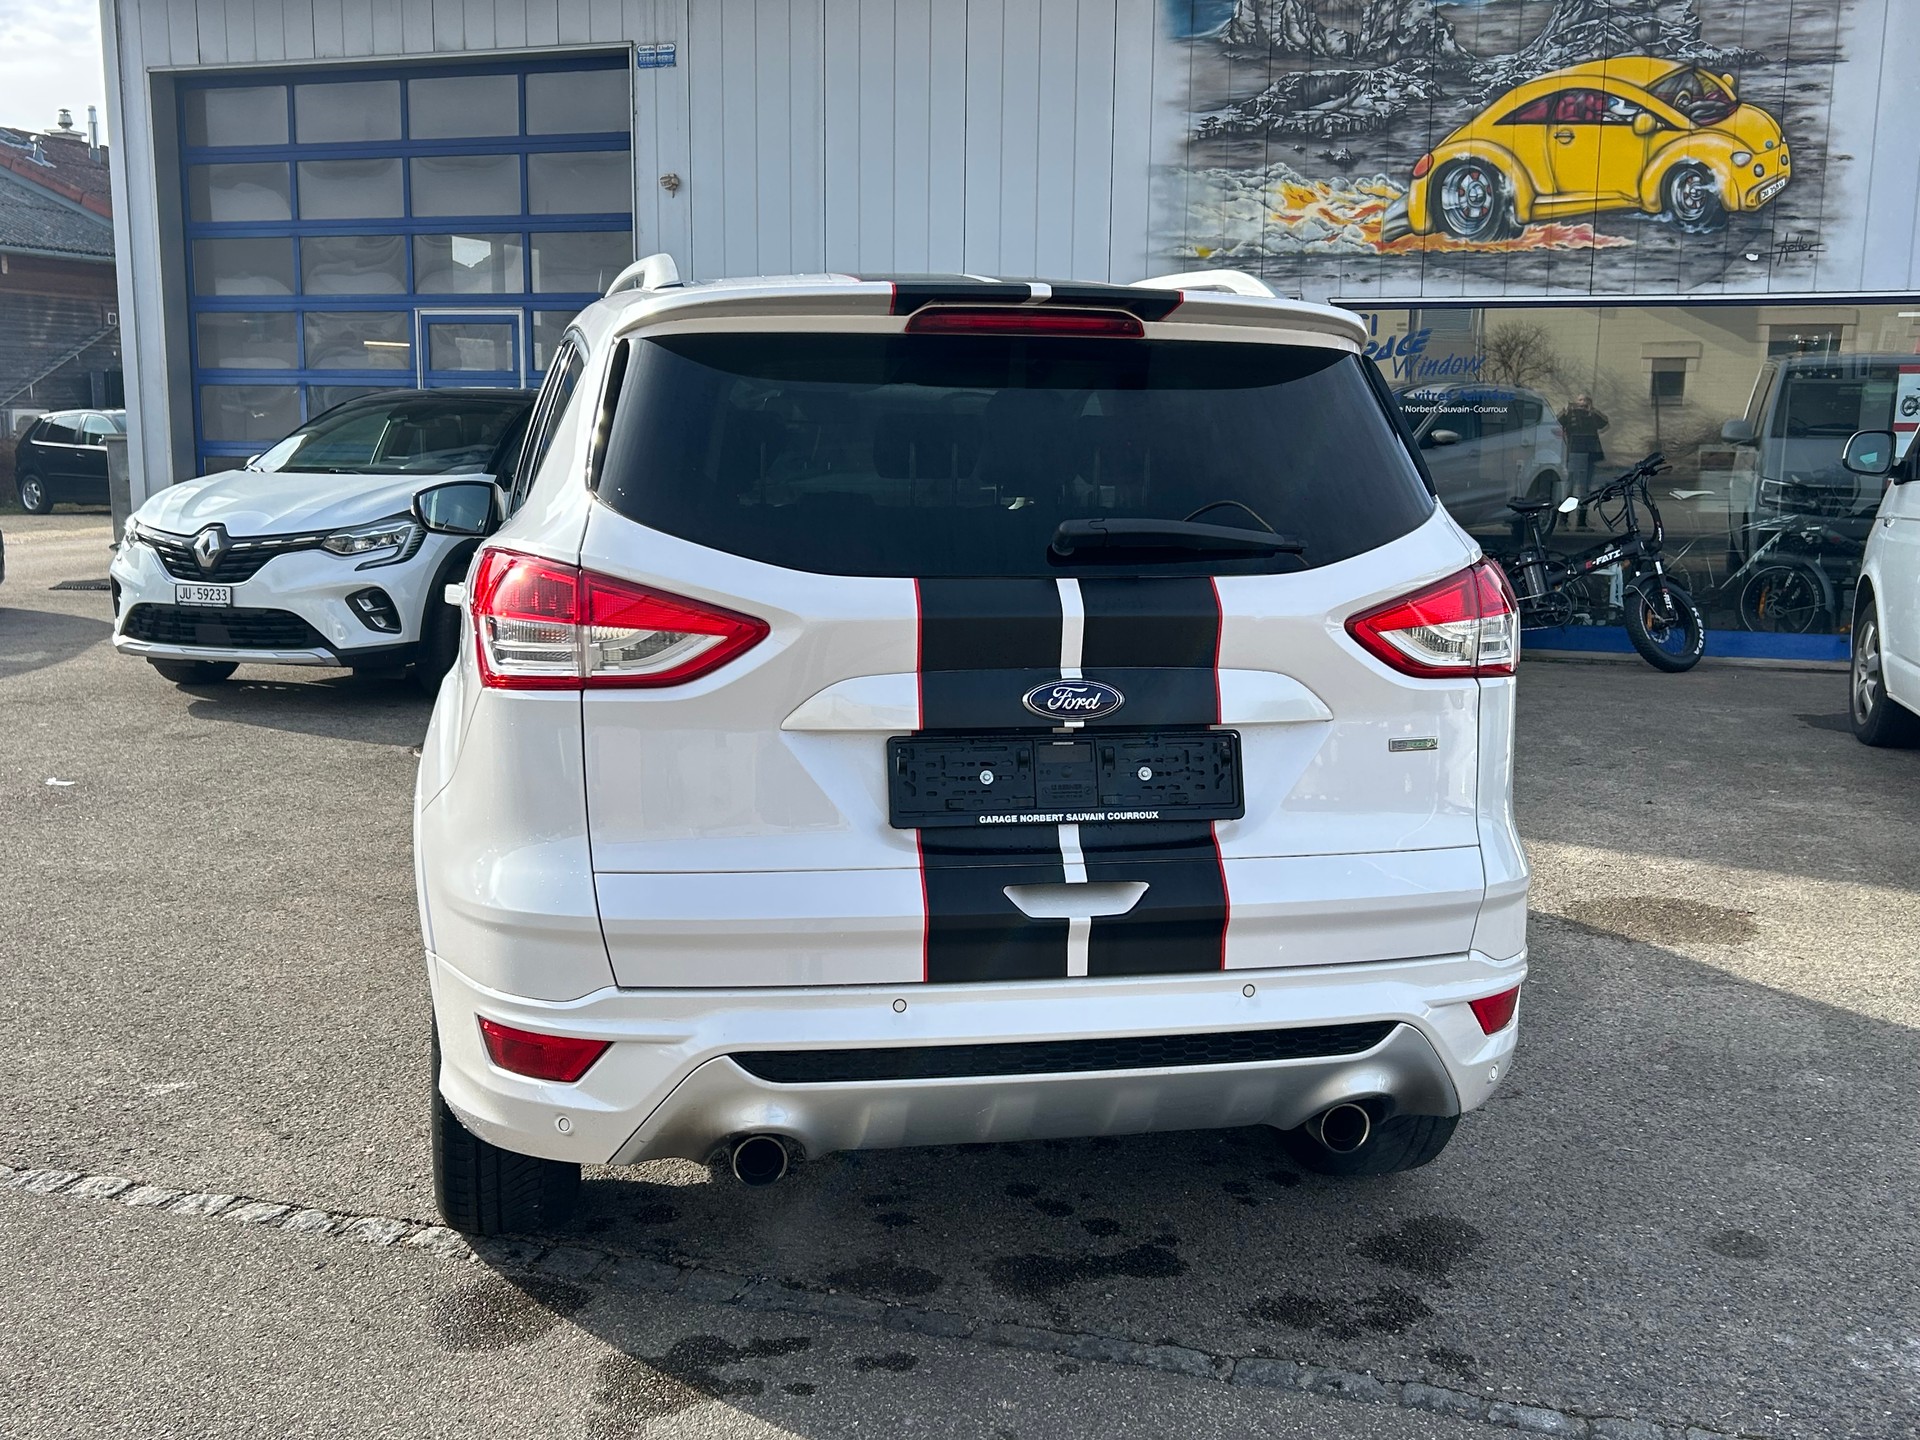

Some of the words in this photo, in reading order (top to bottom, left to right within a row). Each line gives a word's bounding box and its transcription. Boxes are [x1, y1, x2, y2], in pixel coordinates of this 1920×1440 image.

[1392, 352, 1486, 379] Window
[1414, 389, 1452, 401] vitres
[1404, 405, 1437, 413] Norbert
[1438, 405, 1508, 413] Sauvain-Courroux
[1047, 686, 1102, 710] Ford
[979, 815, 1018, 824] GARAGE
[1019, 814, 1064, 823] NORBERT
[1066, 813, 1105, 822] SAUVAIN
[1107, 811, 1160, 821] COURROUX
